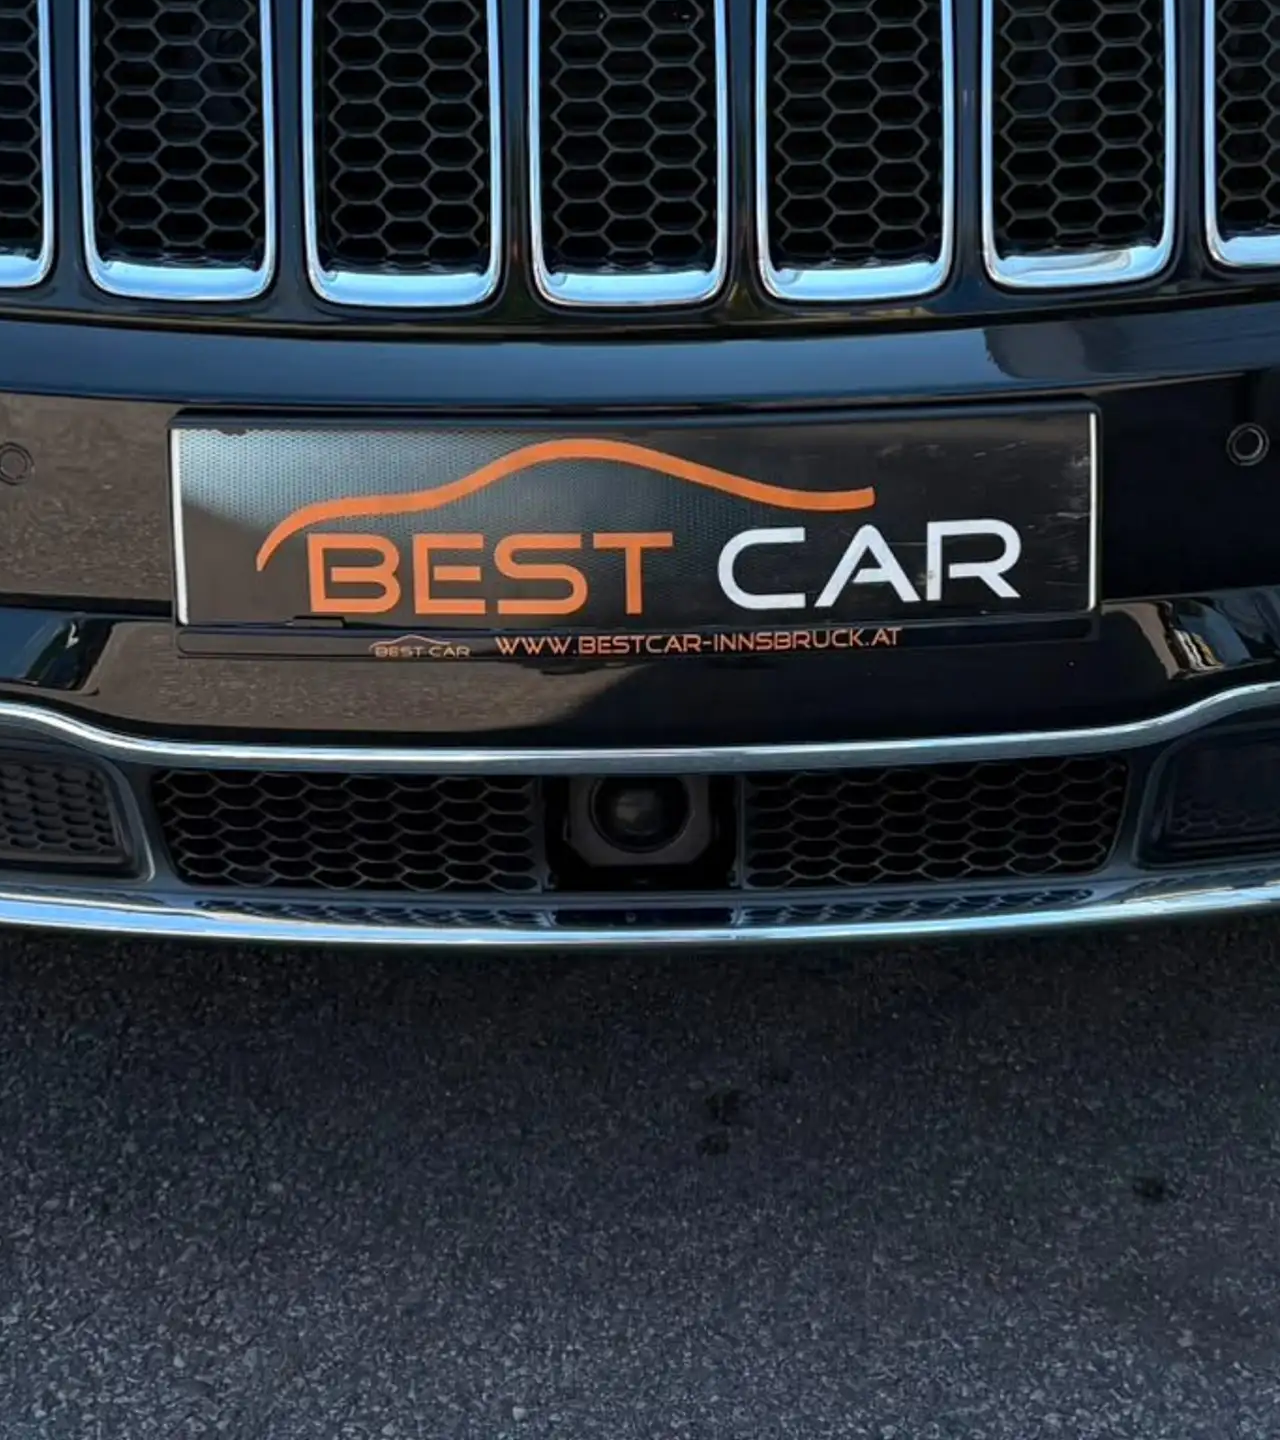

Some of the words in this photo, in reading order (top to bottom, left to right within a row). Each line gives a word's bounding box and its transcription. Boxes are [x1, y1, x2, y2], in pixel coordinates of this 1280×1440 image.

[307, 531, 673, 615] BEST
[717, 518, 1022, 609] CAR
[375, 645, 423, 658] BEST
[428, 645, 471, 658] CAR
[494, 627, 904, 656] WWW.BESTCAR-INNSBRUCK.AT
